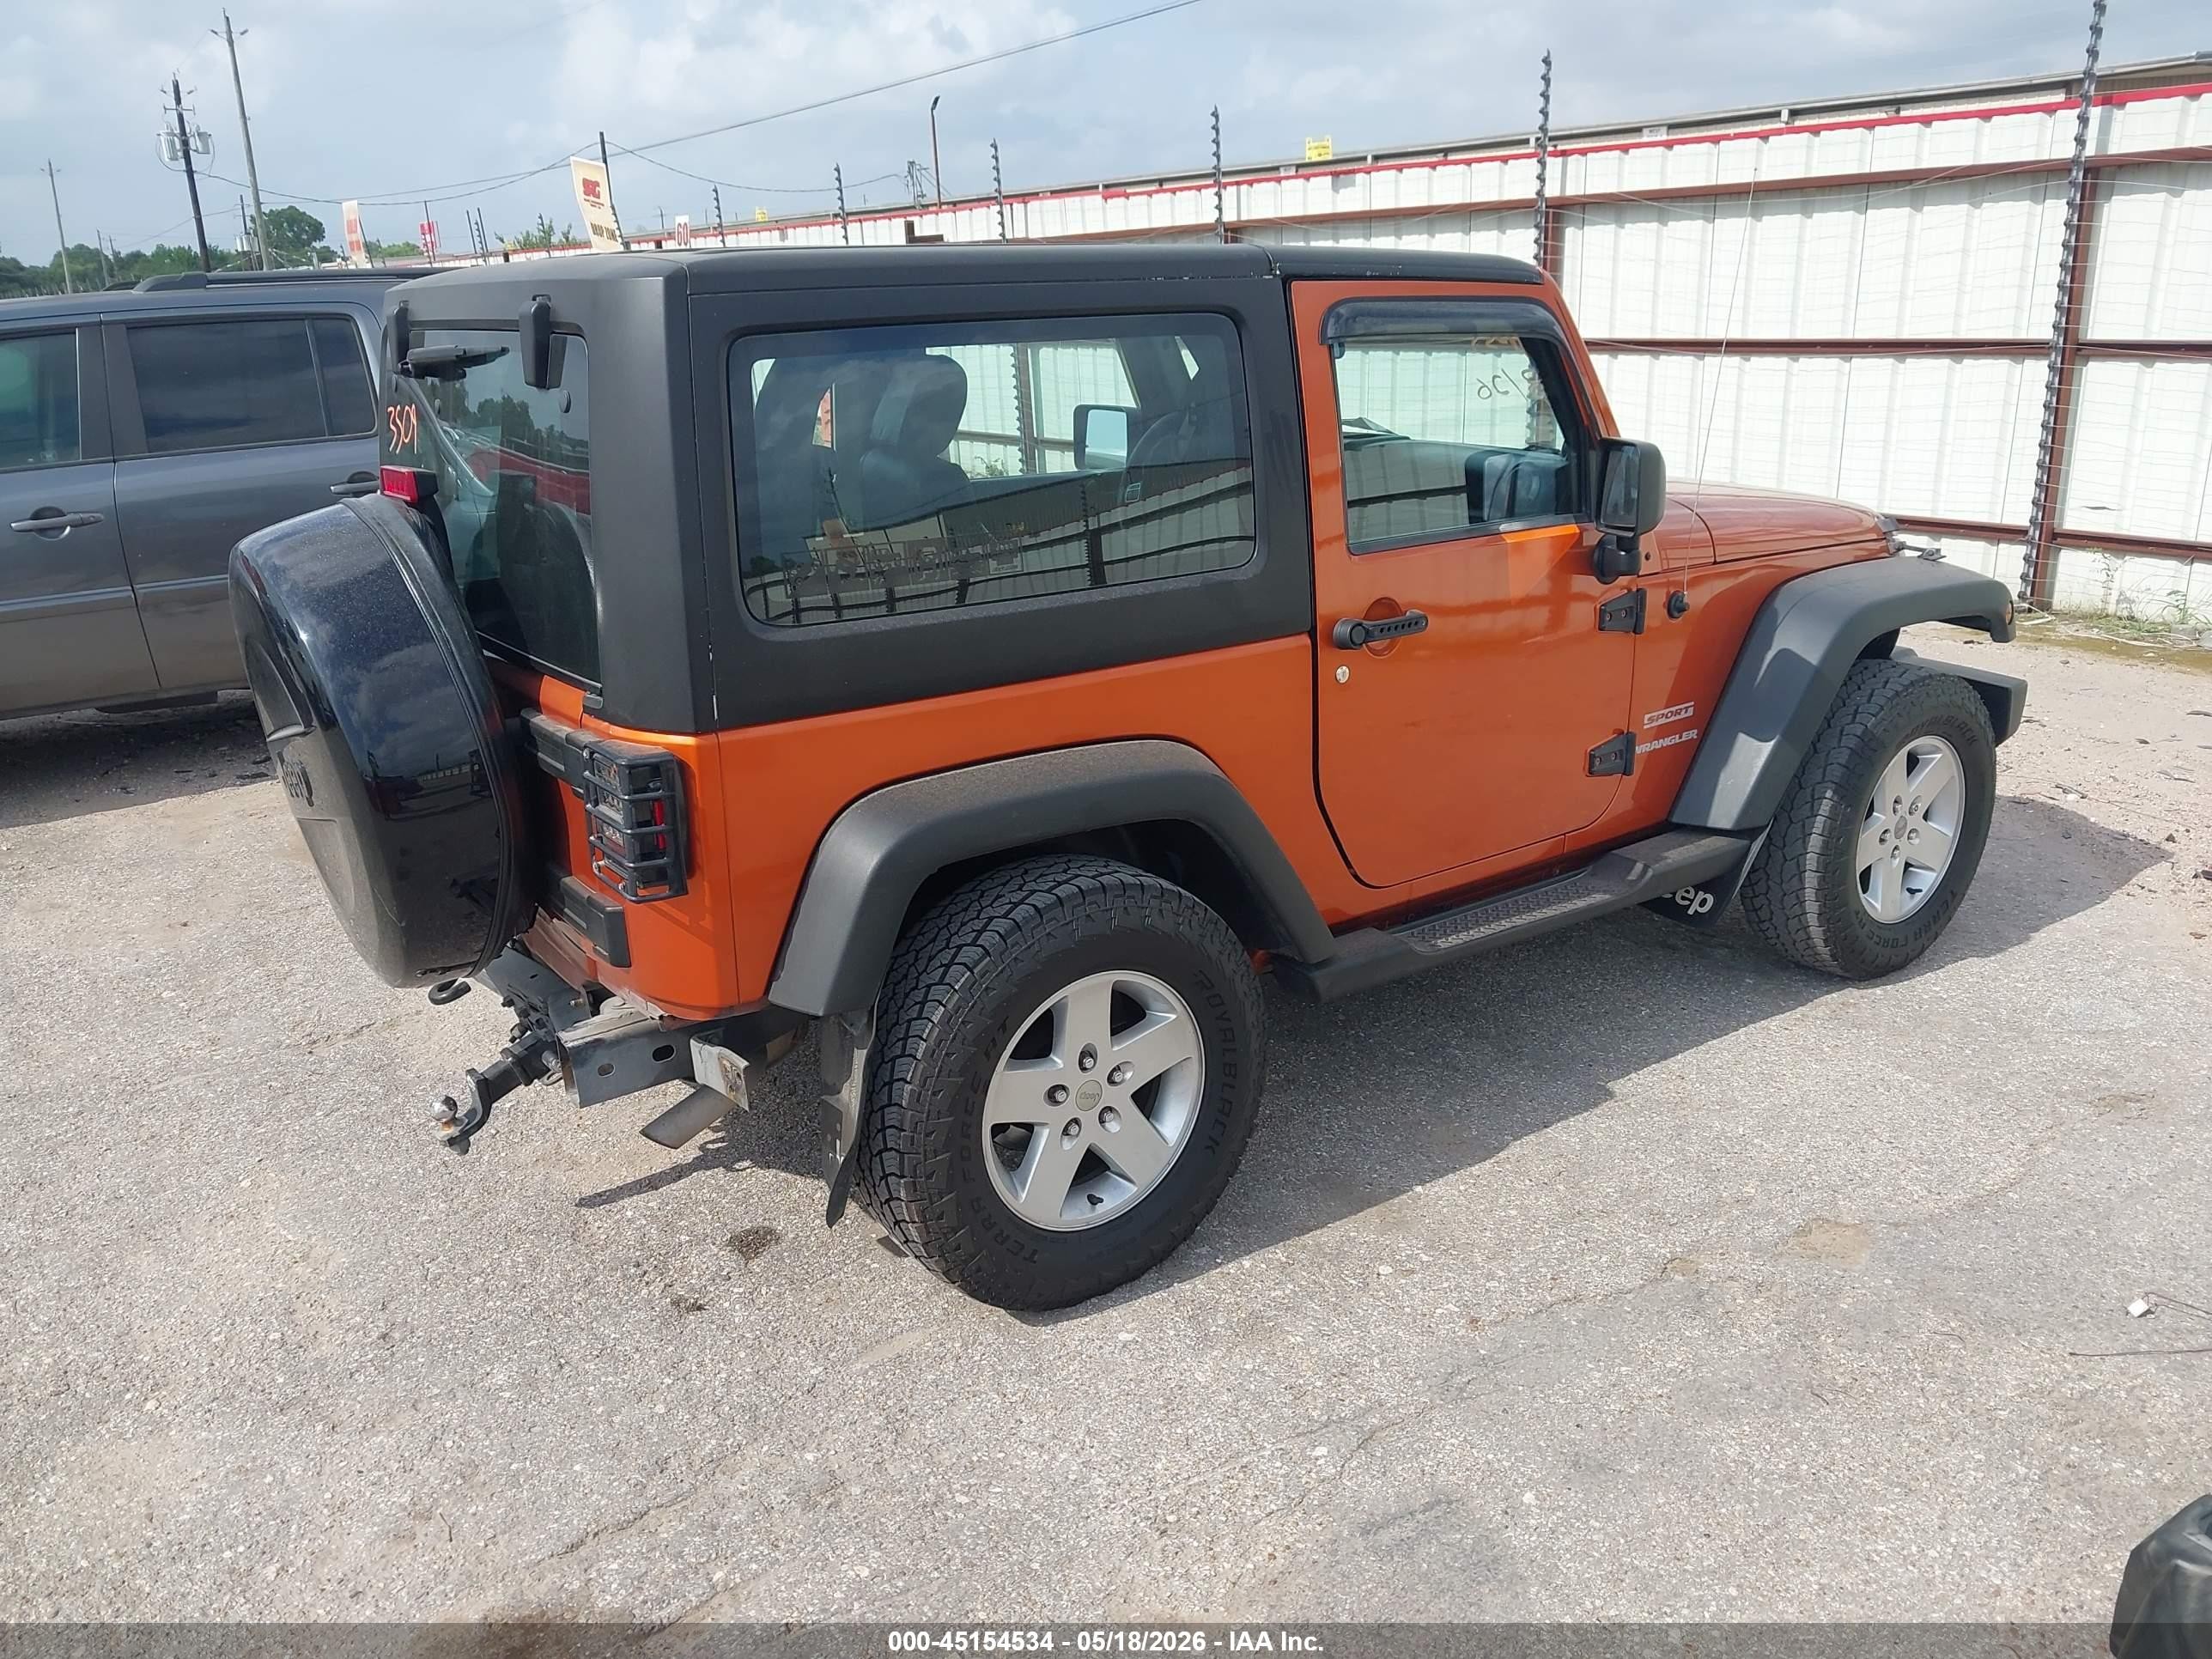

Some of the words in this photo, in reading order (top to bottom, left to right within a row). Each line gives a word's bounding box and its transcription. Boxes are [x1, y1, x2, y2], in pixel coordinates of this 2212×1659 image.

[590, 222, 605, 239] DROP
[604, 227, 619, 243] ZONE
[677, 222, 689, 246] 60
[1647, 707, 1693, 724] SPORT
[960, 1072, 985, 1184] FORCE
